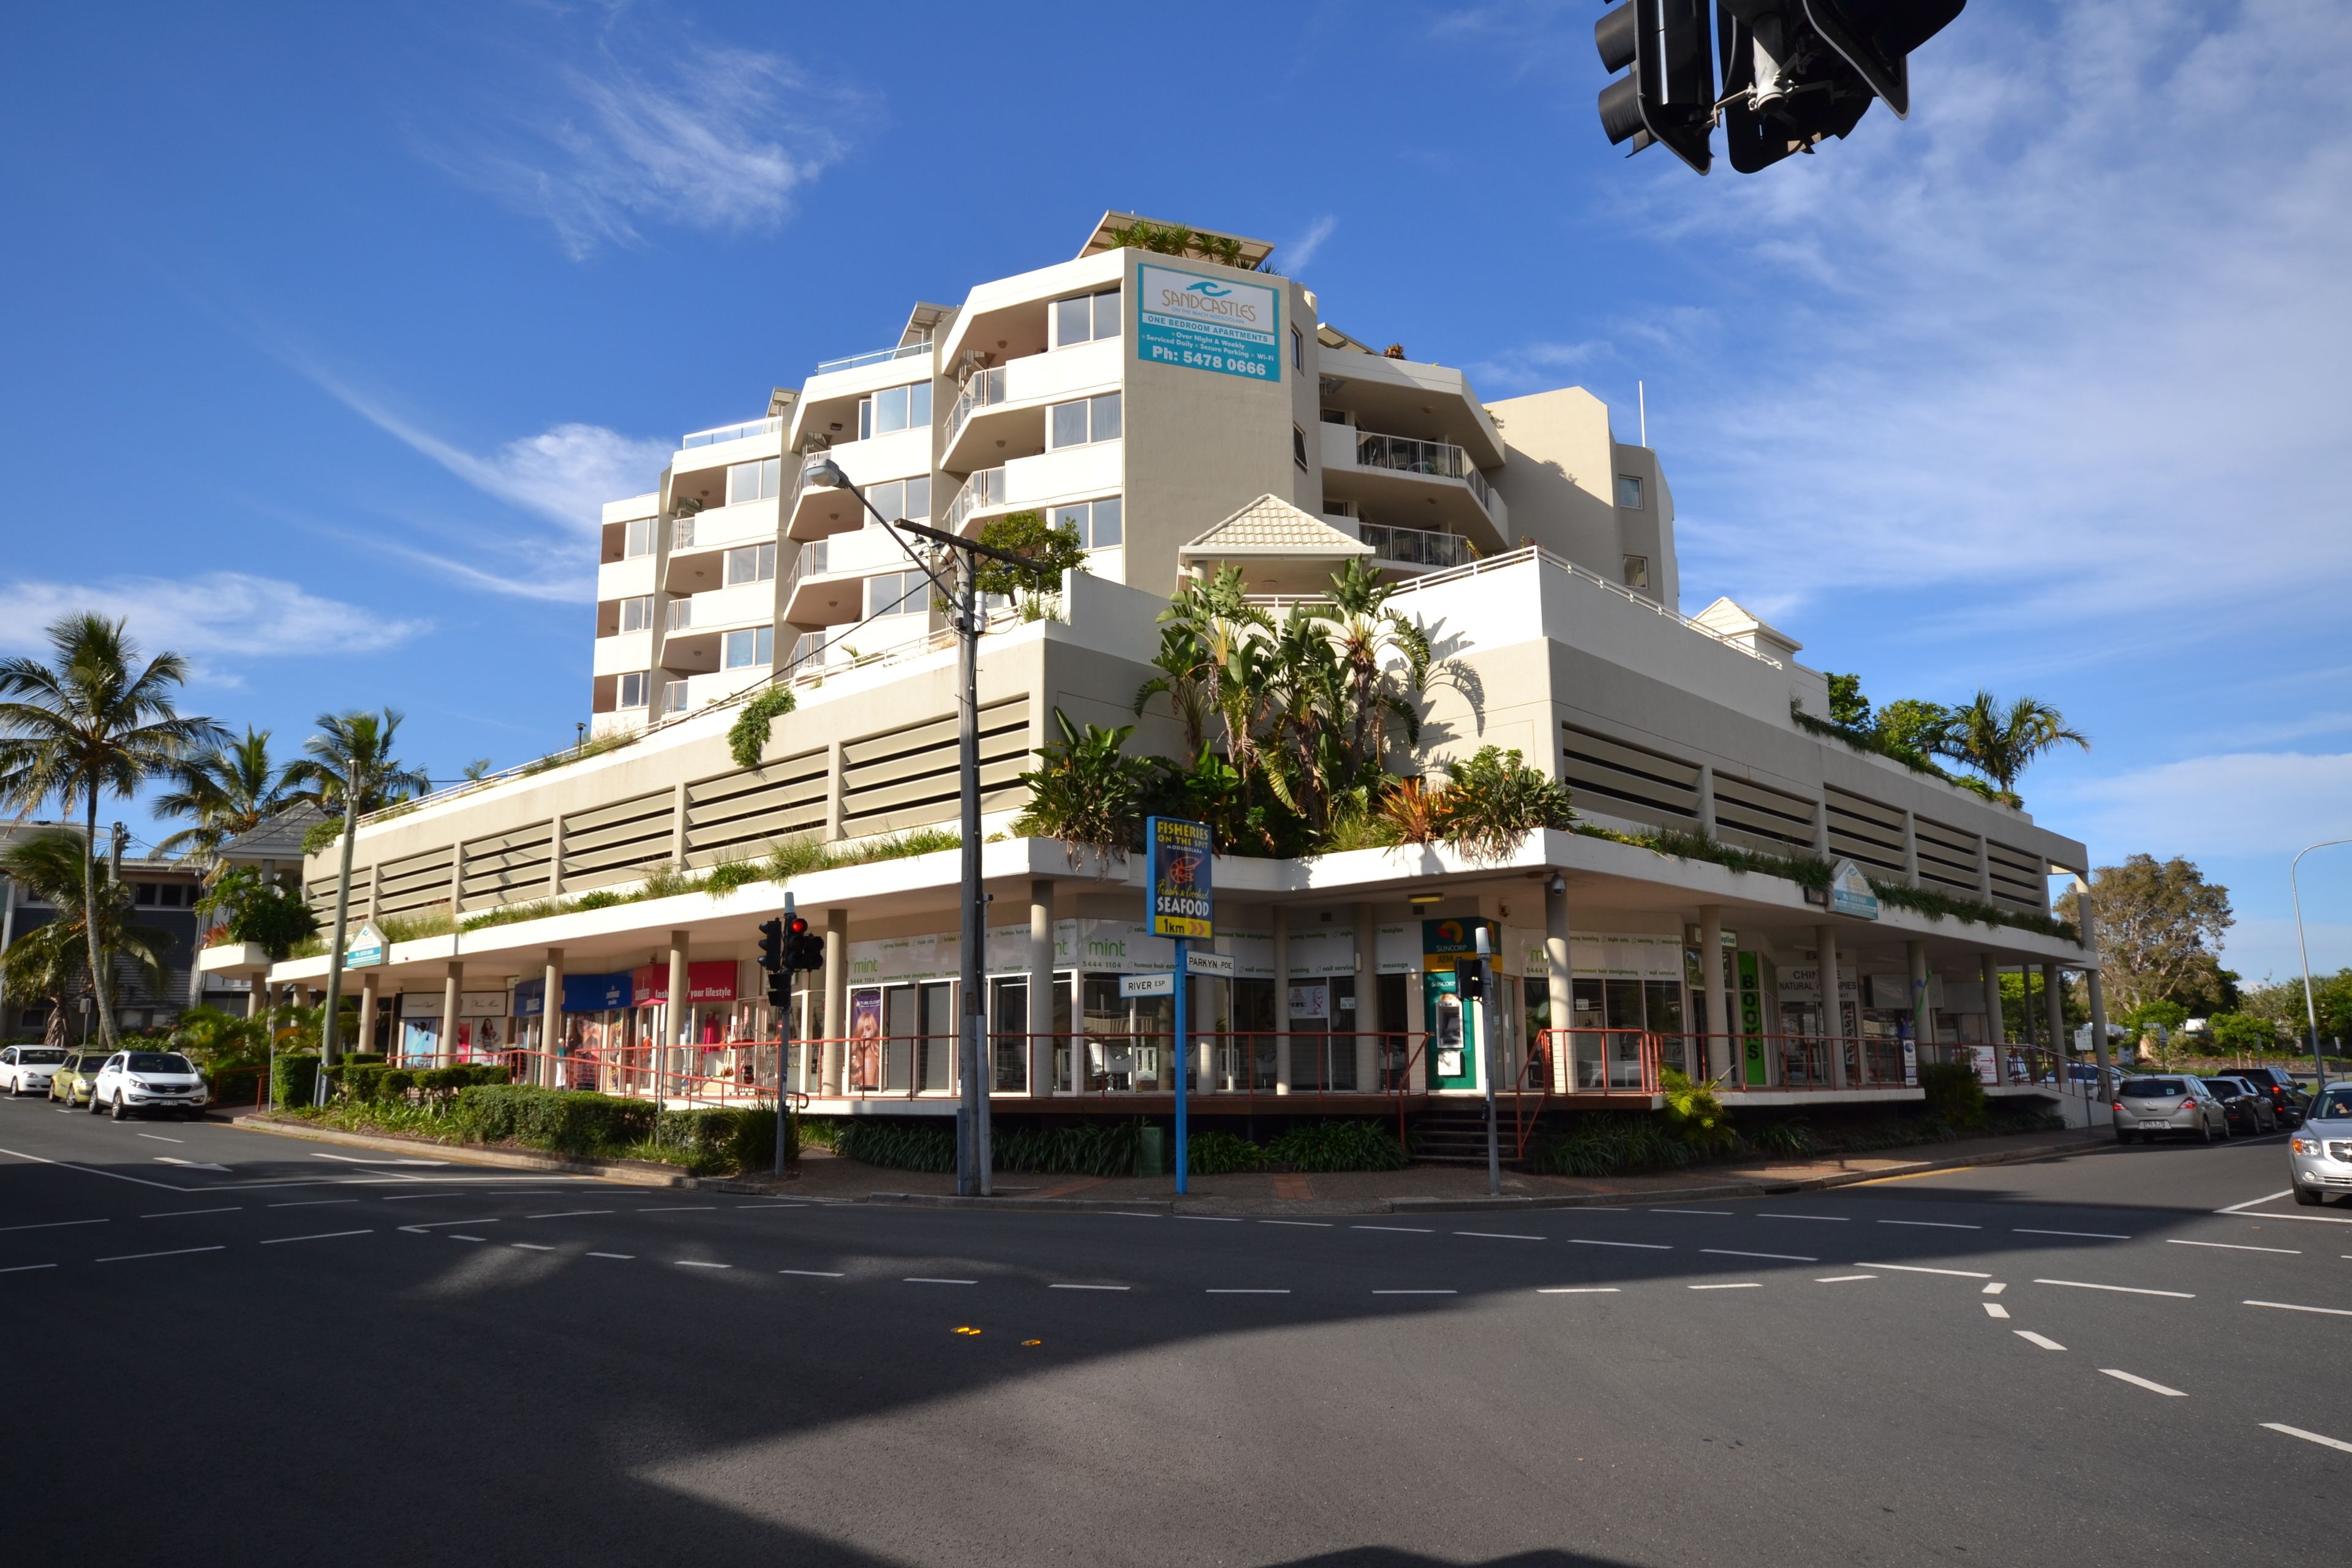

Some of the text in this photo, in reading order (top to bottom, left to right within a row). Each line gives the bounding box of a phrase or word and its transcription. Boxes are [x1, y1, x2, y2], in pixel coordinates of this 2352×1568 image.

[1161, 288, 1256, 322] SANDCASTLES
[1148, 315, 1268, 342] ONE BEDROOM APARTMENTS
[1210, 314, 1245, 325] MOOLOOLABA
[1146, 334, 1274, 362] Serviced Daily Secure Parking Wi-Fi
[1176, 331, 1193, 341] Over
[1194, 334, 1213, 345] Night
[1221, 338, 1245, 350] Weekly
[1152, 345, 1267, 376] Ph: 5478 0666
[1157, 821, 1209, 840] FISHERIES
[1158, 834, 1208, 849] ON THE SPIT
[1156, 878, 1179, 897] Fresh
[1186, 884, 1210, 900] Cooked
[1156, 896, 1210, 918] SEAFOOD
[1163, 918, 1185, 935] 1km
[1054, 938, 1068, 956] nt
[1088, 938, 1126, 957] mint
[1436, 944, 1468, 952] SUNCORP
[854, 957, 878, 974] mint
[1188, 957, 1218, 969] PARKYN
[1437, 955, 1454, 963] ATM
[690, 989, 704, 1000] your
[705, 987, 731, 998] lifestyle
[1128, 980, 1152, 991] RIVER
[1779, 981, 1814, 990] NATURAL
[1742, 974, 1760, 1060] BOOKS
